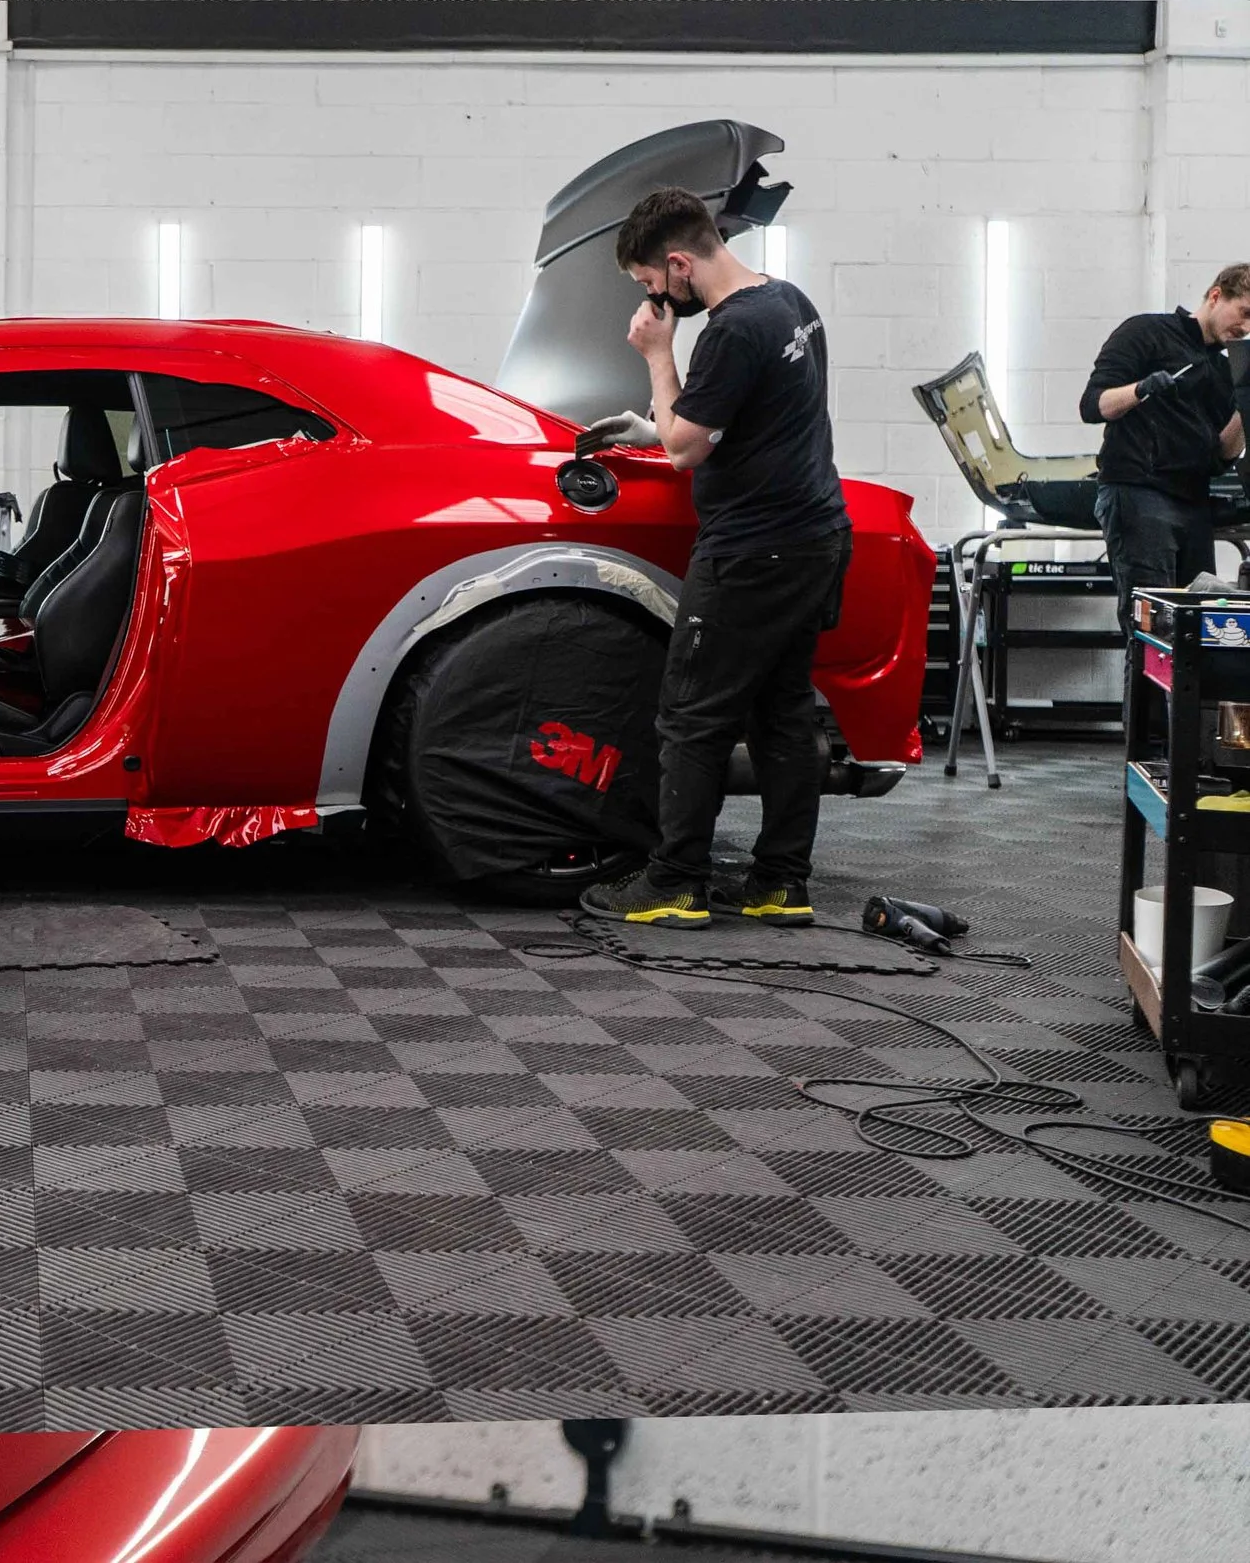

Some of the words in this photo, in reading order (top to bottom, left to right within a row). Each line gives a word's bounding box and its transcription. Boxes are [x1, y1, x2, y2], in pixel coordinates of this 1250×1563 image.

[1028, 563, 1043, 573] tic
[1045, 563, 1064, 573] tac
[530, 721, 622, 793] 3M
